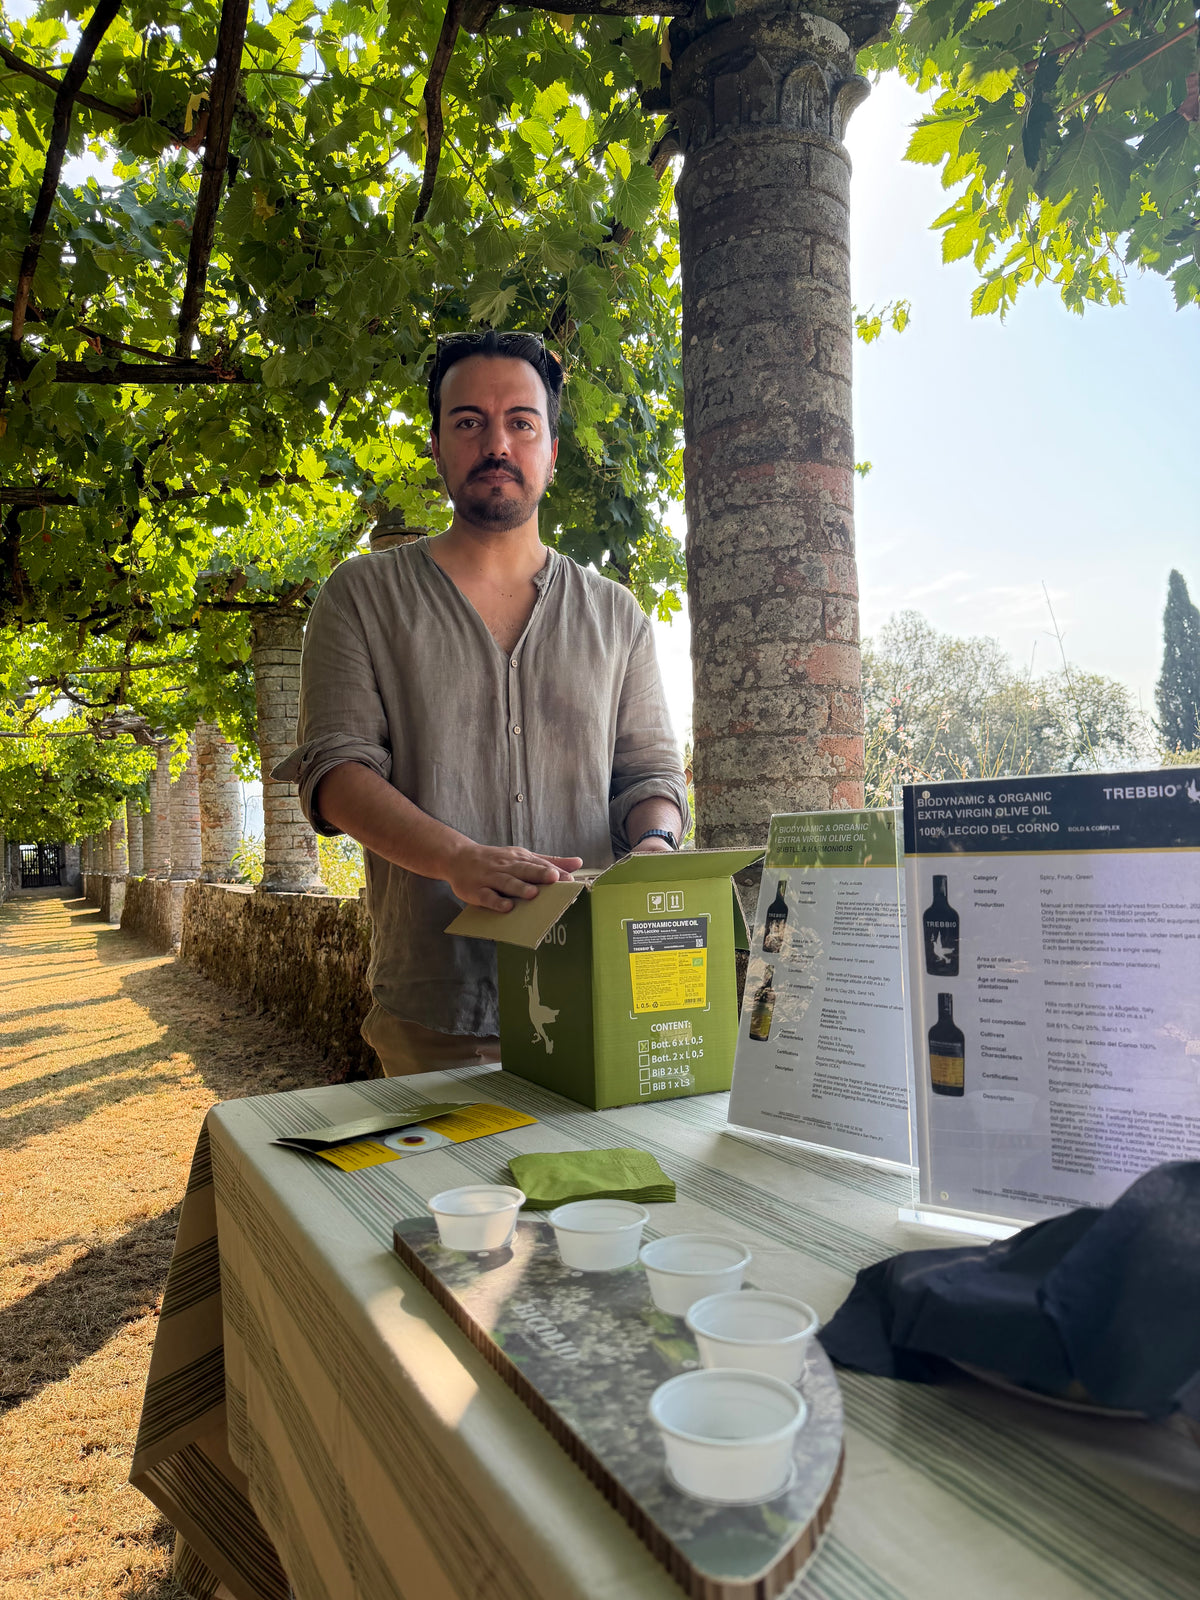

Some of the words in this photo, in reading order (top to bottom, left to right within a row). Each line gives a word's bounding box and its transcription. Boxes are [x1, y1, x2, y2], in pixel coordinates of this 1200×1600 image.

[917, 794, 985, 808] BIODYNAMIC
[987, 793, 996, 804] &
[998, 791, 1052, 804] ORGANIC
[917, 809, 953, 820] EXTRA
[955, 807, 993, 819] VIRGIN
[995, 806, 1030, 817] OLIVE
[1032, 804, 1052, 816] OIL
[779, 823, 824, 834] BIODYNAMIC
[832, 822, 869, 832] ORGANIC
[919, 826, 946, 837] 100%
[948, 824, 989, 836] LECCIO
[991, 823, 1014, 834] DEL
[1016, 822, 1060, 834] CORNO
[1091, 824, 1121, 832] COMPLEX
[777, 835, 801, 844] EXTRA
[802, 834, 827, 843] VIRGIN
[829, 834, 851, 842] OLIVE
[853, 834, 867, 842] OIL
[632, 921, 673, 930] BIODYNAMIC
[673, 919, 689, 927] OLIVE
[650, 1020, 692, 1033] CONTENT:
[651, 1040, 671, 1050] Bott.
[672, 1038, 678, 1047] 6
[678, 1039, 684, 1047] x
[691, 1035, 704, 1045] 0,5
[651, 1054, 672, 1064] Bott.
[672, 1052, 678, 1061] 2
[685, 1050, 691, 1059] L
[691, 1049, 704, 1059] 0,5
[652, 1067, 666, 1077] BiB
[667, 1066, 673, 1075] 2
[652, 1081, 666, 1091] BiB
